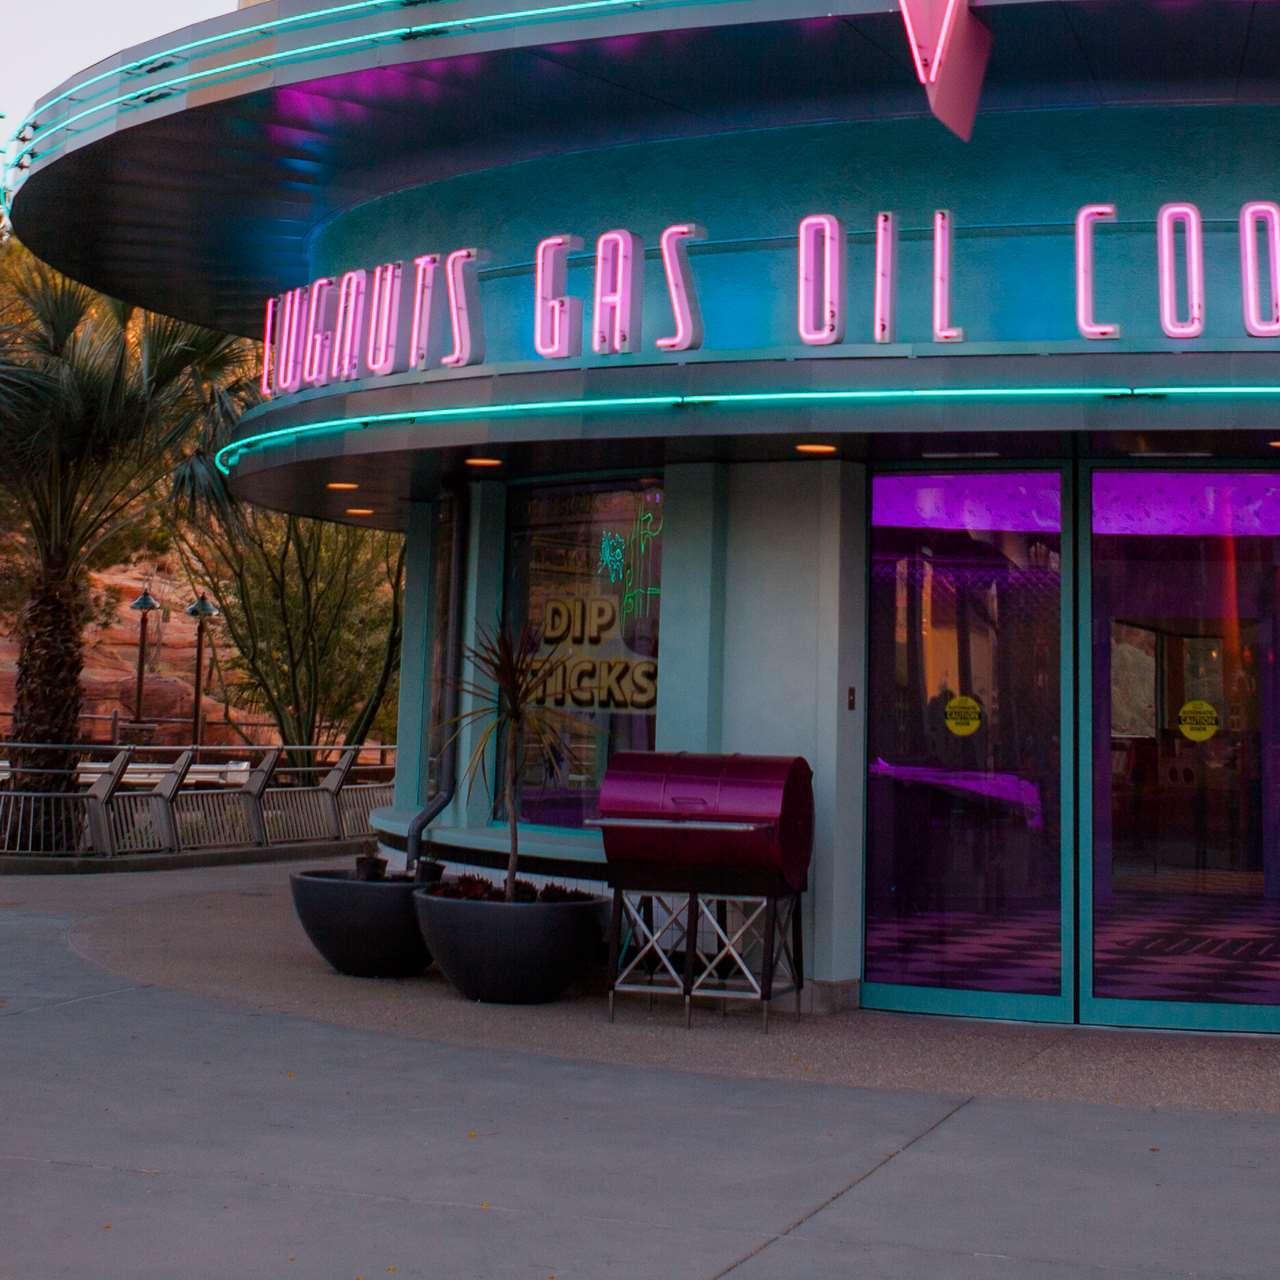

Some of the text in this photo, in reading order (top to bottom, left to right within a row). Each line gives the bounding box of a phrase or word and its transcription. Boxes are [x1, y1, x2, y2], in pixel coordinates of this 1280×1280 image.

[261, 248, 484, 398] LUGNUTS
[532, 223, 706, 358] GAS
[796, 209, 965, 346] OIL
[543, 598, 617, 645] DIP
[520, 657, 658, 709] TICKS
